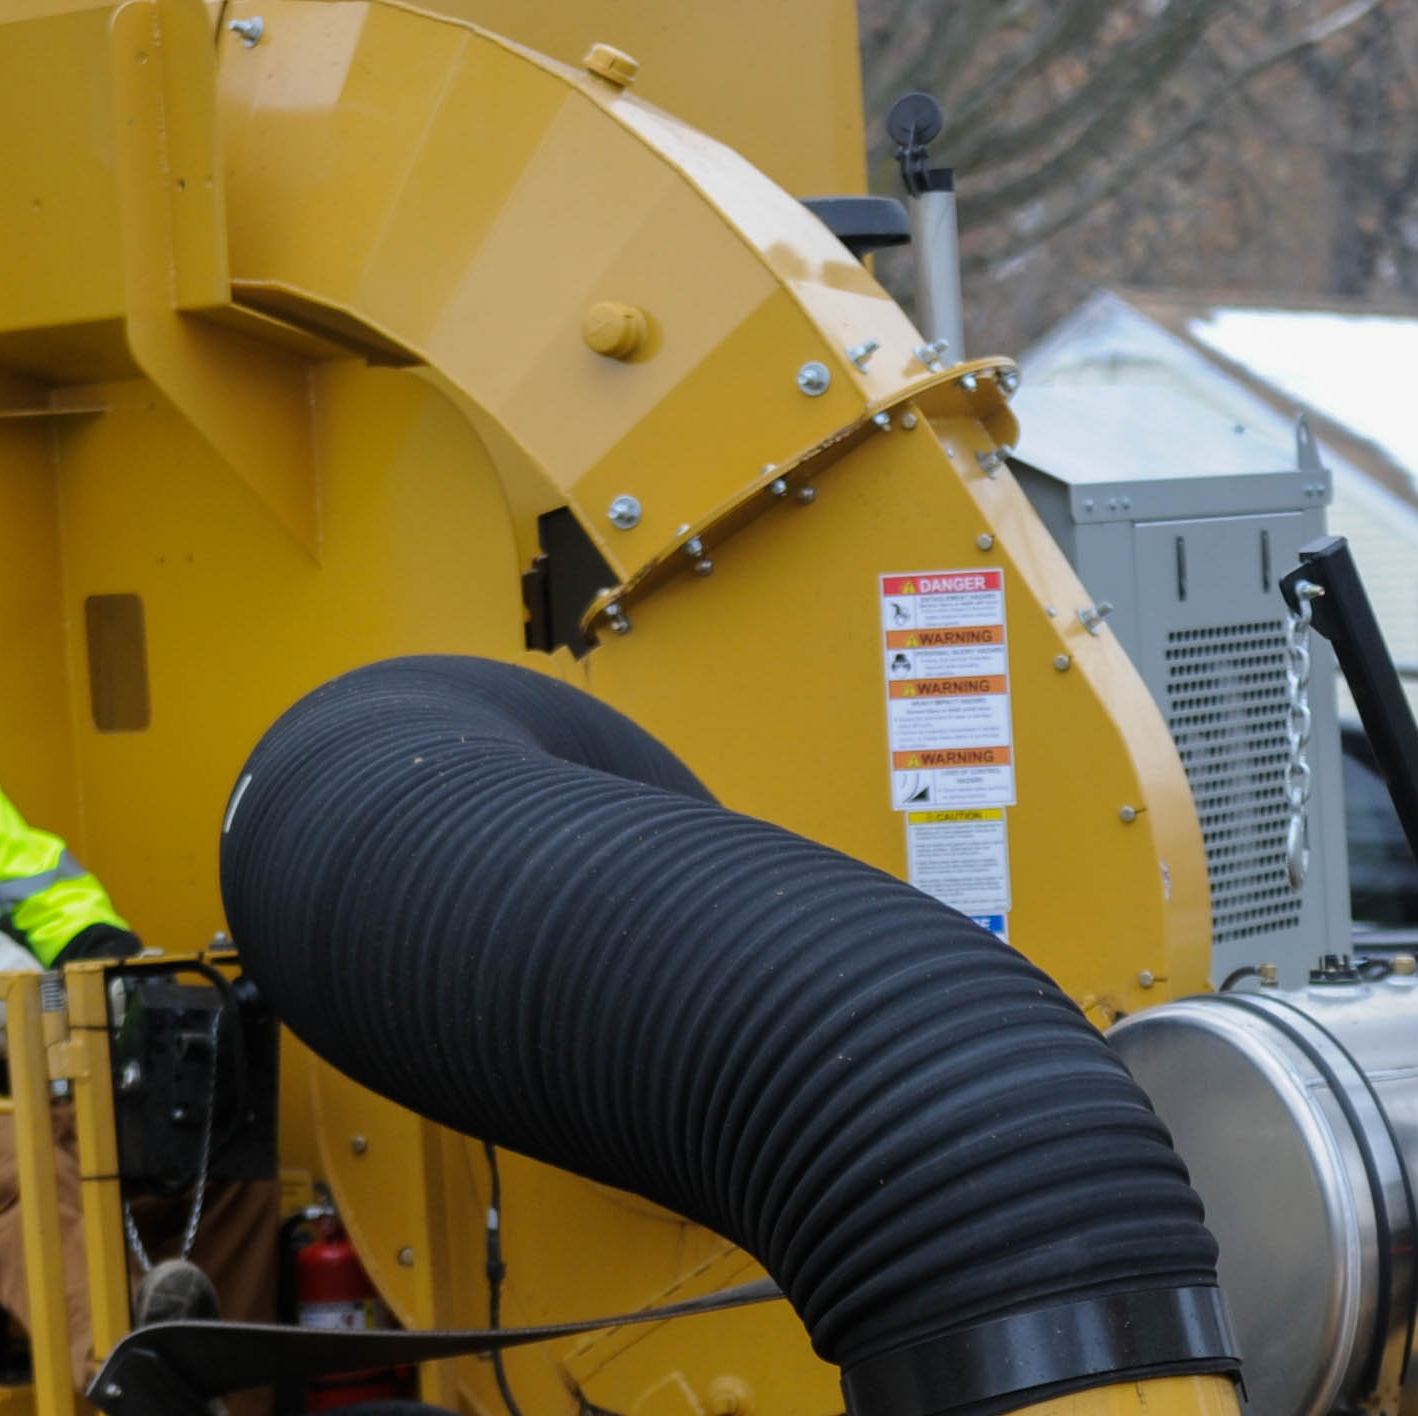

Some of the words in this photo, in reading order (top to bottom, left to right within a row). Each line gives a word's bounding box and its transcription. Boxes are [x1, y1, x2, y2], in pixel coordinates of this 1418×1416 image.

[919, 576, 986, 593] DANGER
[919, 629, 993, 646] WARNING
[917, 680, 990, 696] WARNING
[921, 750, 994, 766] WARNING
